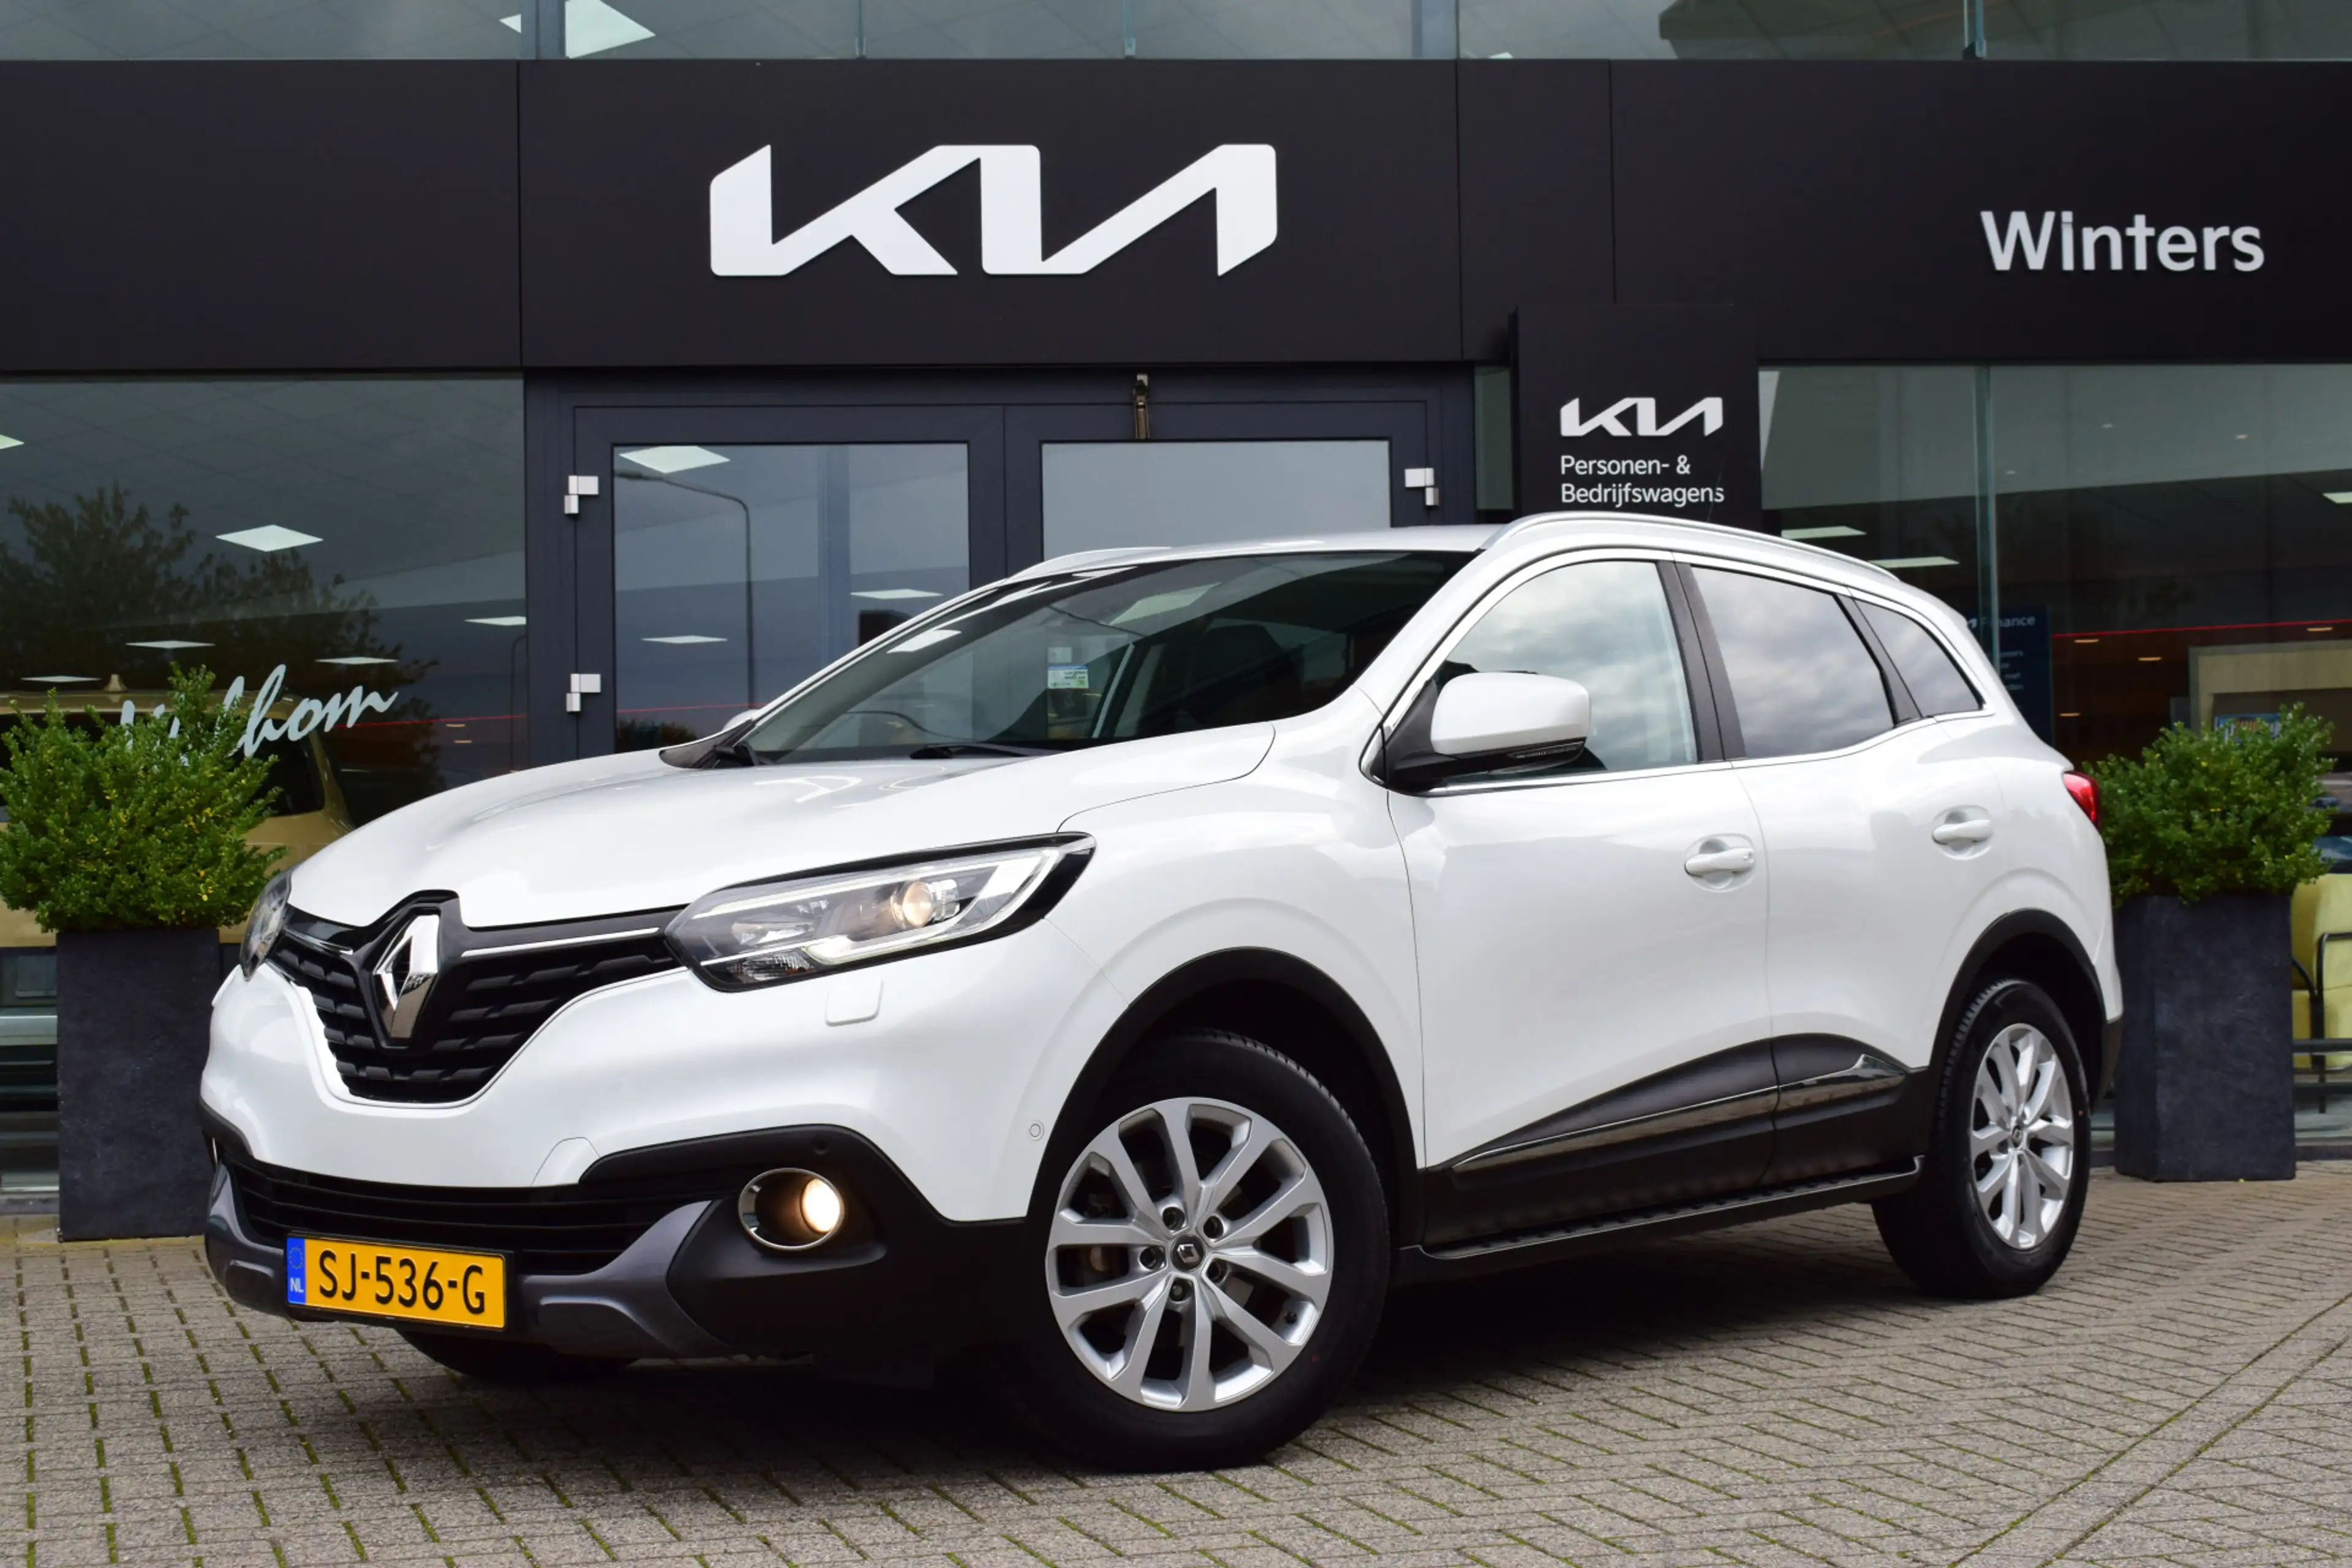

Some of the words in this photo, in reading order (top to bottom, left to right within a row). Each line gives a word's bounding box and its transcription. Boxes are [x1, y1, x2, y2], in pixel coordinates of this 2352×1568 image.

[710, 144, 1277, 277] KIA
[1980, 211, 2265, 271] Winters
[1559, 397, 1724, 437] KIA
[1560, 454, 1670, 475] Personen-
[1676, 454, 1691, 475] &
[1561, 483, 1725, 507] Bedrijfswagens
[290, 1277, 304, 1294] NL
[318, 1249, 486, 1315] SJ-536-G
